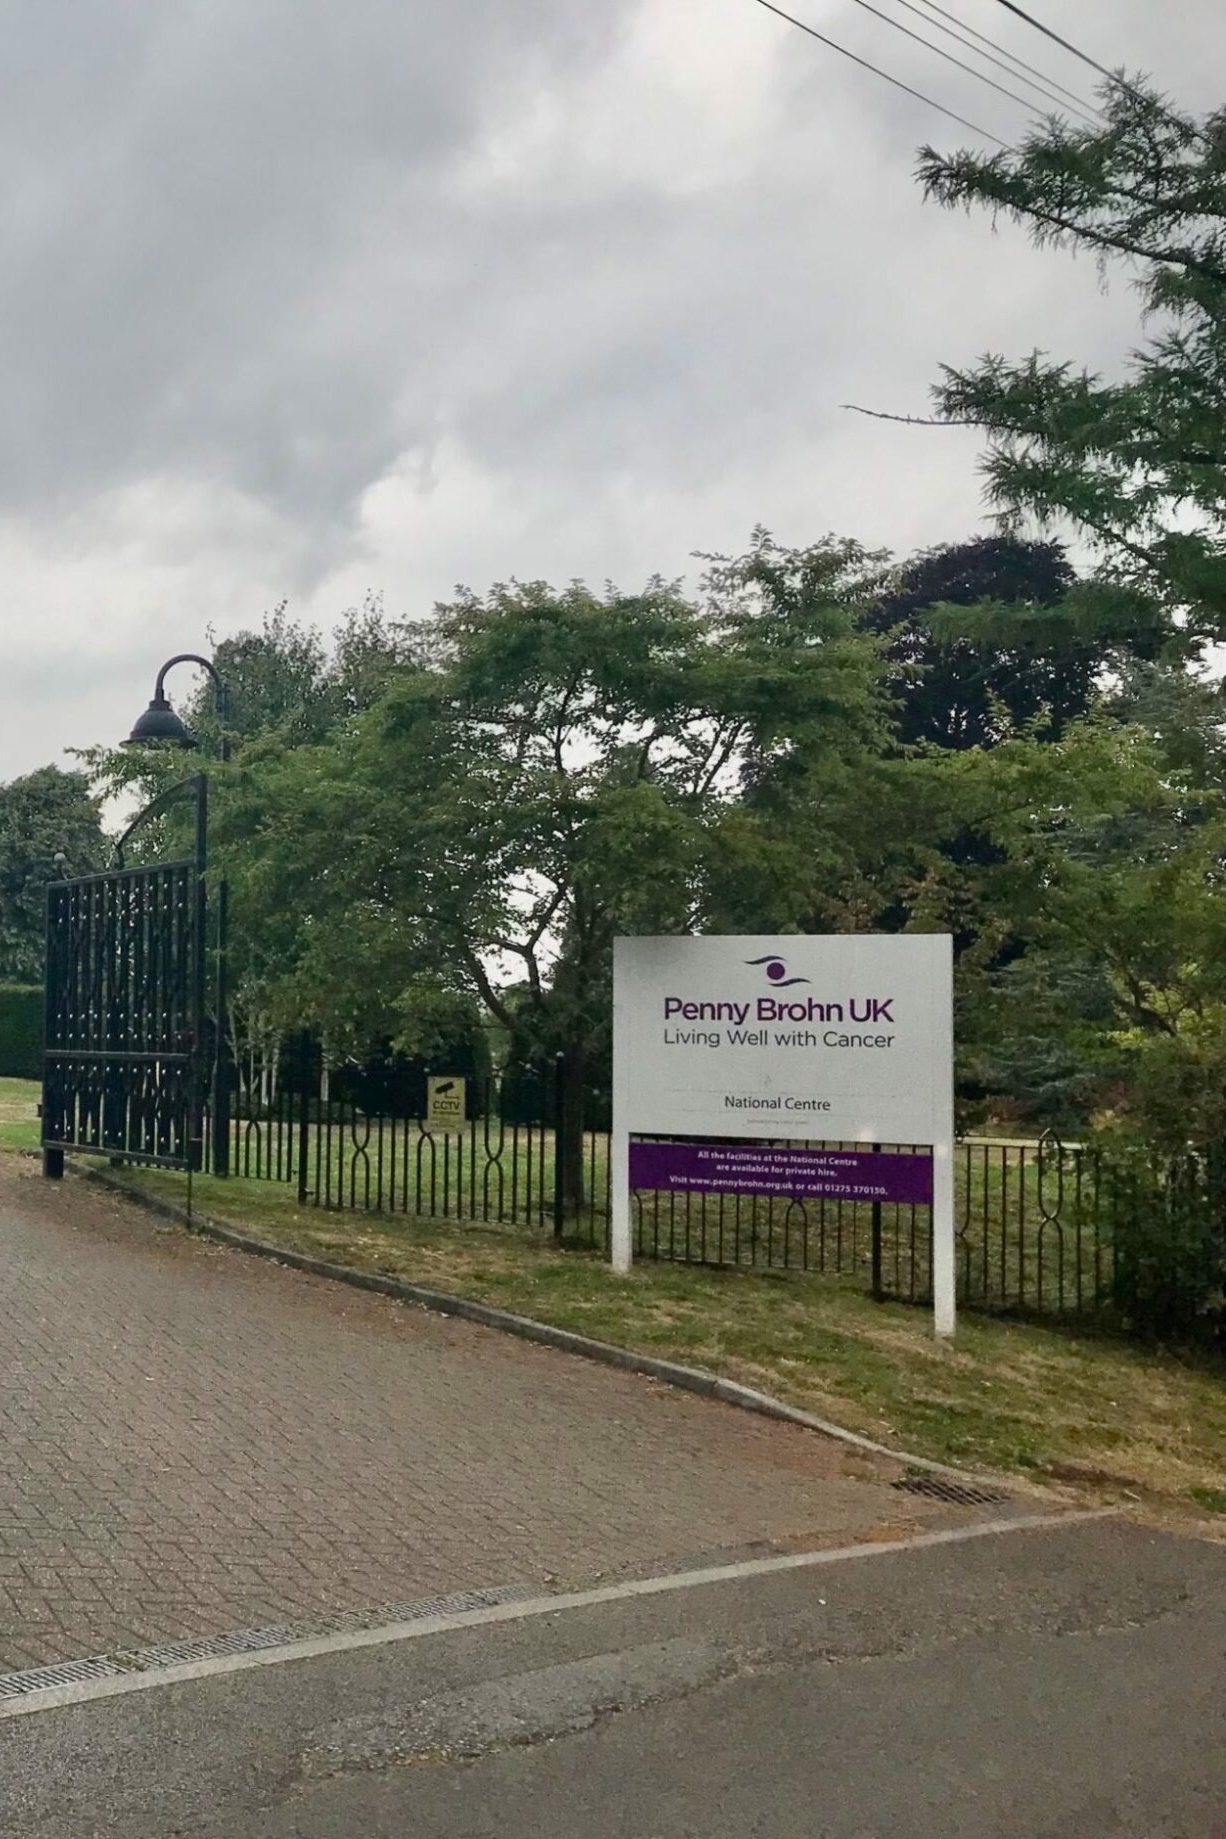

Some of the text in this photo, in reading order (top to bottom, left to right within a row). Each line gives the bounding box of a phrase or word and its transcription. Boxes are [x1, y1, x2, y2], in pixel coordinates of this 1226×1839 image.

[664, 997, 894, 1025] Penny Brohn UK
[664, 1029, 894, 1048] Living Well with Cancer
[433, 1101, 460, 1110] CCTV
[724, 1096, 831, 1111] National Centre
[697, 1151, 857, 1166] All the facilities at the National Centre
[731, 1164, 769, 1173] available
[771, 1166, 783, 1174] for
[785, 1167, 815, 1175] private
[817, 1168, 838, 1176] hire.
[669, 1175, 687, 1183] Visit
[689, 1177, 793, 1190] www.pennybrohn.org.uk
[807, 1183, 823, 1191] call
